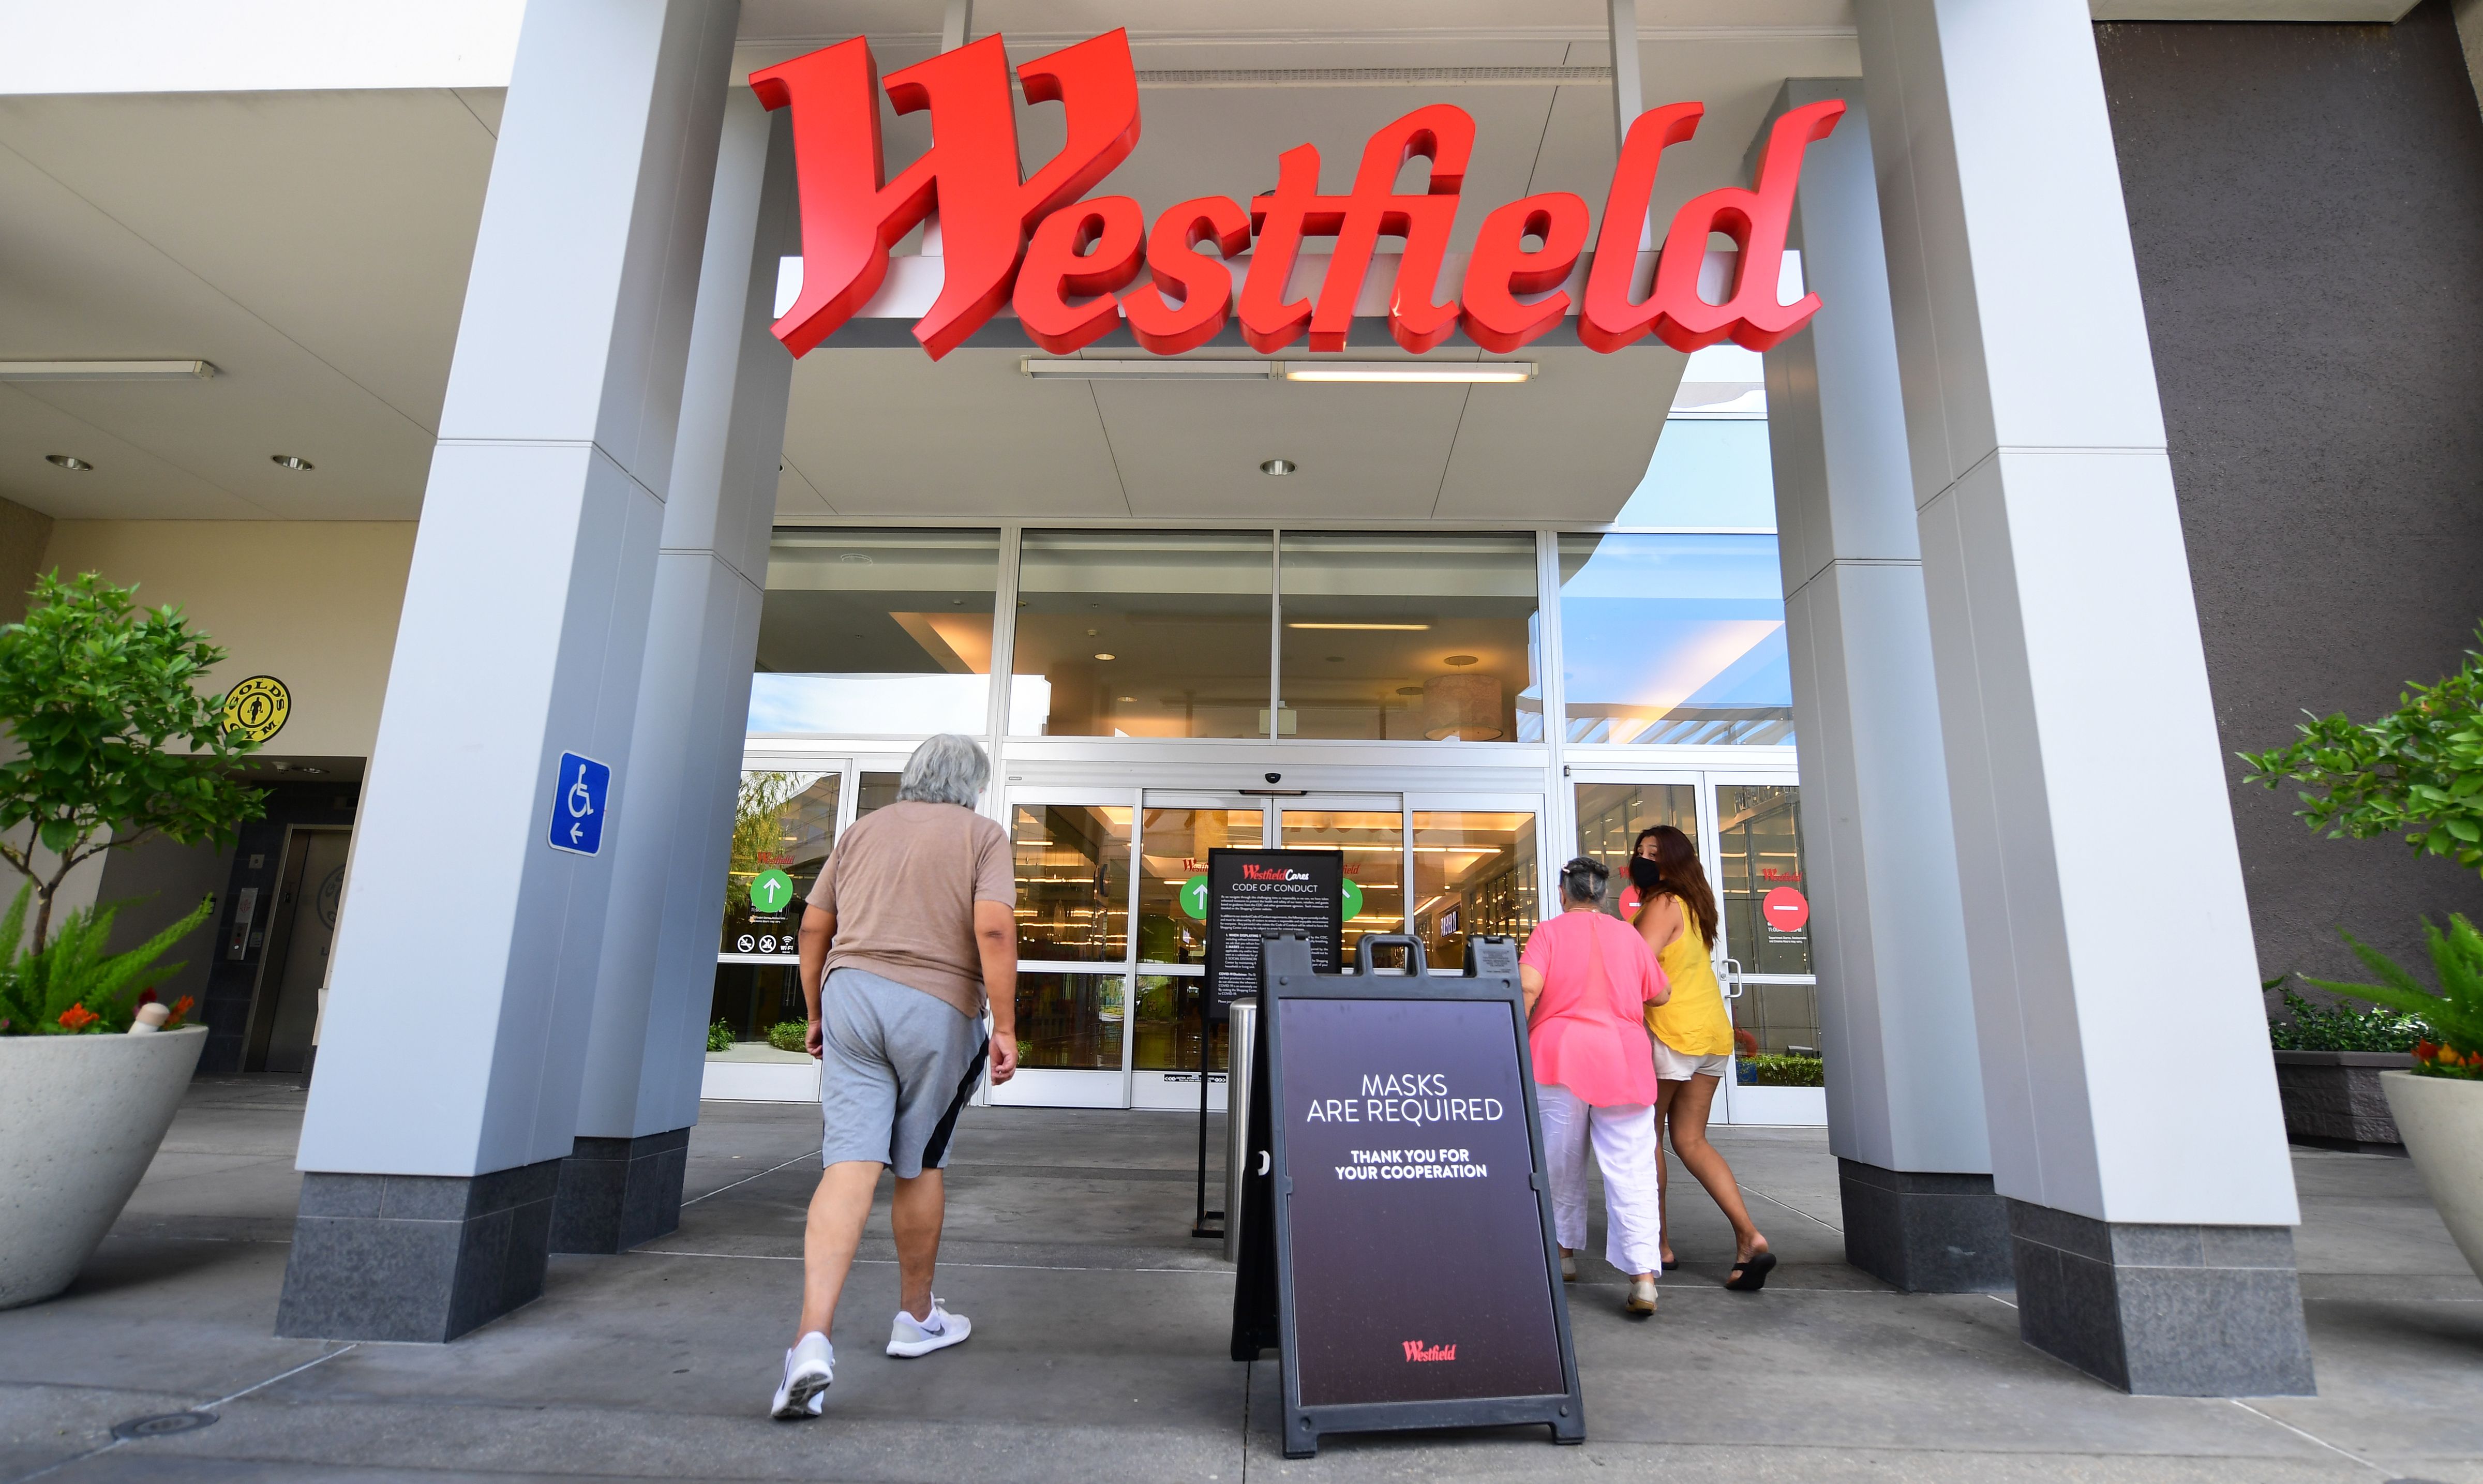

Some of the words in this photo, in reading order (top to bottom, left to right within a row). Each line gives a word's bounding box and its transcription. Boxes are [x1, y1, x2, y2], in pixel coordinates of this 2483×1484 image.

[748, 27, 1848, 360] Westfield
[229, 681, 285, 711] GOLD'S
[1763, 868, 1803, 882] Westfield
[1274, 884, 1318, 892] CONDUCT
[1362, 1074, 1447, 1096] MASKS
[1307, 1099, 1359, 1122] ARE
[1367, 1098, 1503, 1127] REQUIRED
[1351, 1150, 1402, 1163] THANK
[1404, 1149, 1435, 1163] YOU
[1439, 1149, 1470, 1162] FOR
[1335, 1166, 1378, 1180] YOUR
[1381, 1164, 1487, 1179] COOPERATION
[1402, 1340, 1457, 1362] Westfield
